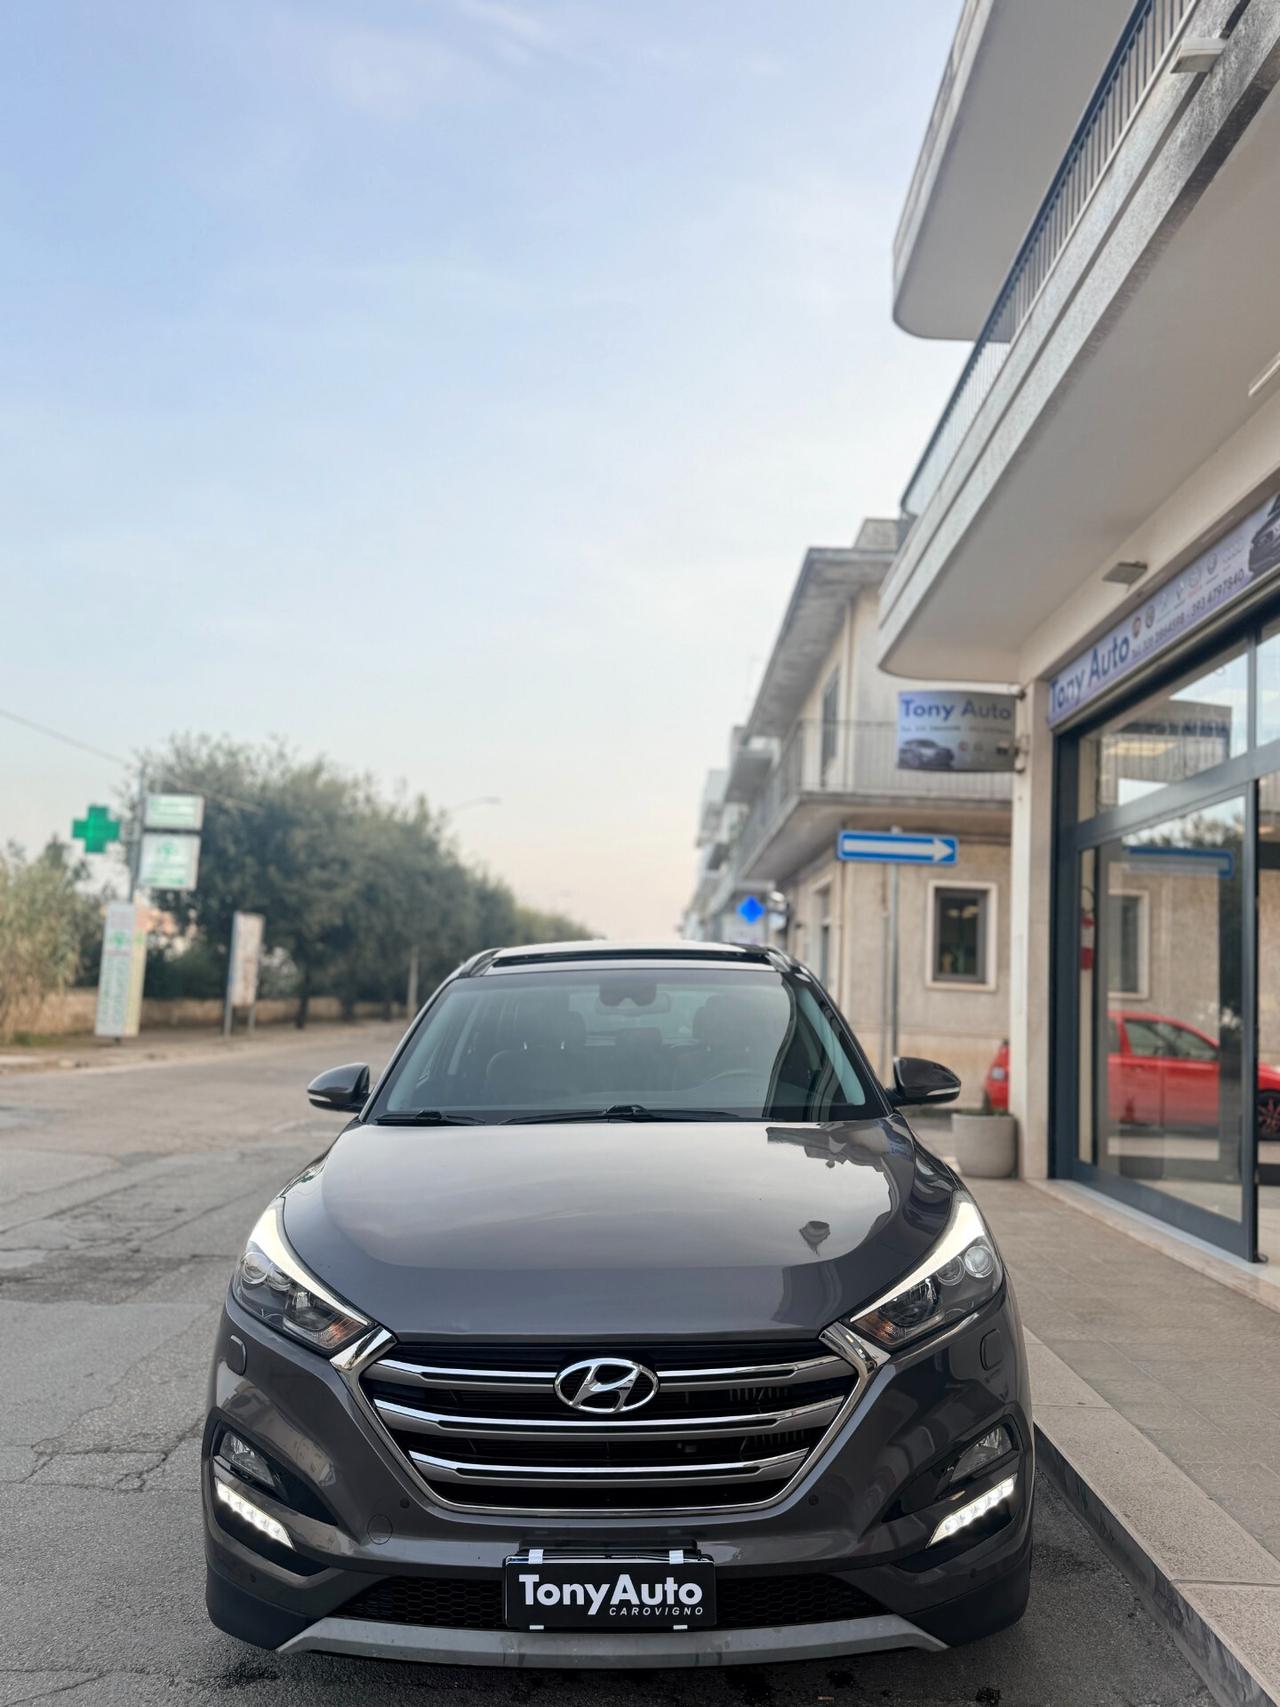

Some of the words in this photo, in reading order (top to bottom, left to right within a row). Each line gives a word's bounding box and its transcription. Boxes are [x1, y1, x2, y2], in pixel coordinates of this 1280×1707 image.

[1050, 669, 1086, 713] Tony
[1087, 636, 1130, 689] Auto
[901, 698, 955, 722] Tony
[961, 698, 1012, 721] Auto
[608, 1606, 704, 1616] CAROVIGNO
